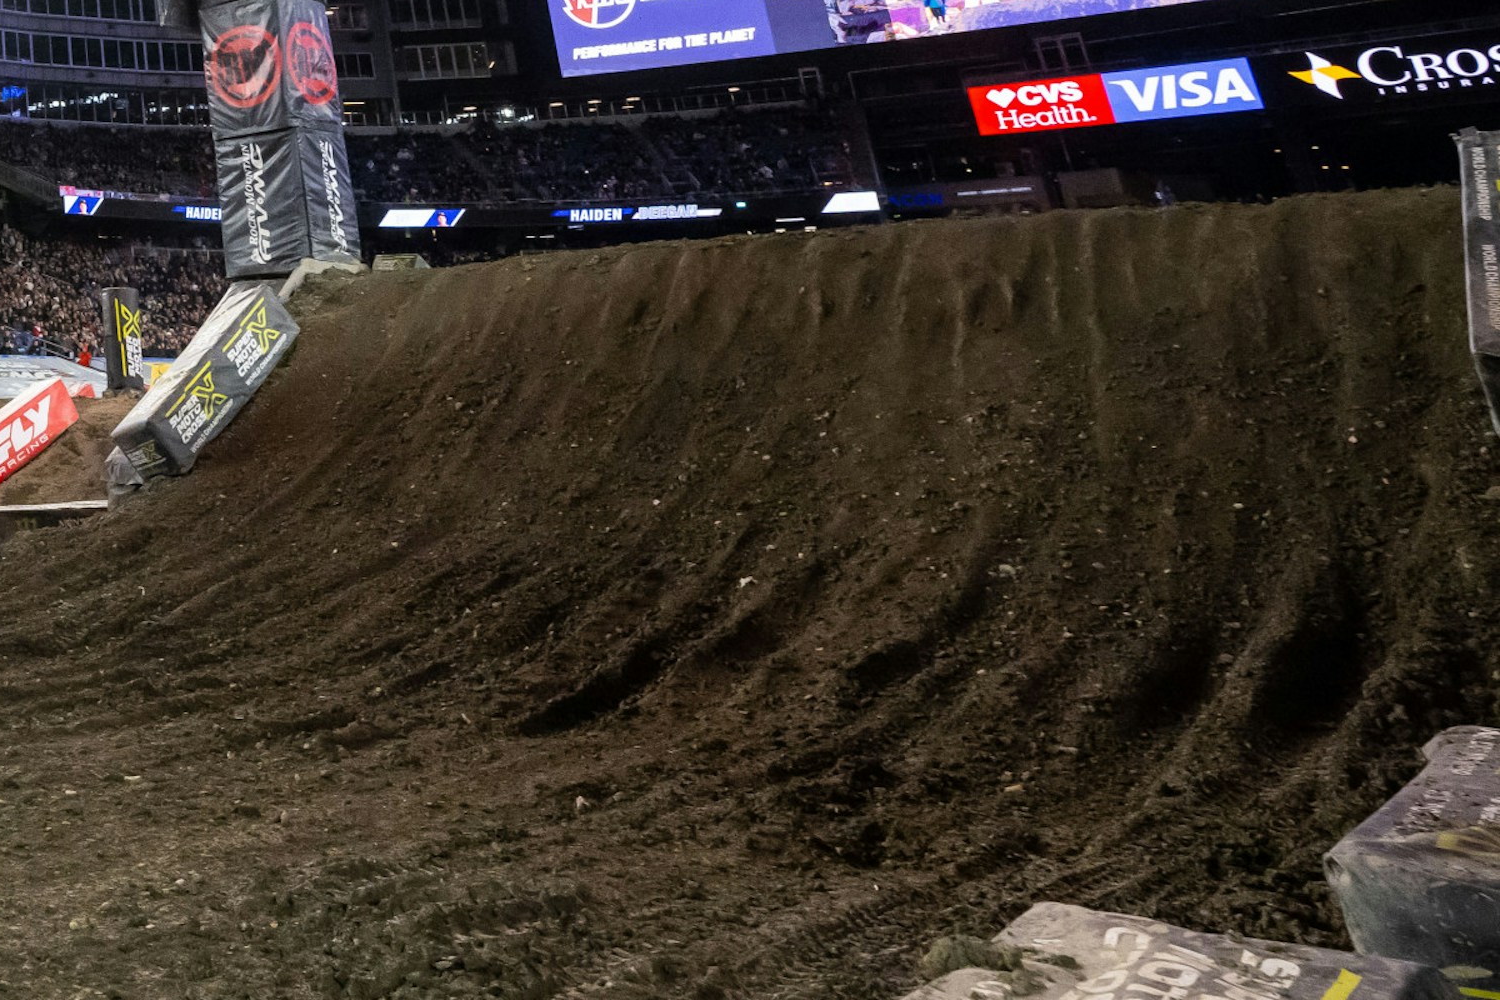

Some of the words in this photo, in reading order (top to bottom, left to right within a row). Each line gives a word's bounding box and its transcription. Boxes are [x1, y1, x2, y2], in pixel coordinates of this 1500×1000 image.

[573, 38, 657, 60] PERFORMANCE
[659, 35, 683, 51] FOR
[684, 32, 708, 48] THE
[710, 26, 756, 44] PLANET
[1016, 81, 1084, 106] CVS
[1108, 67, 1255, 112] VISA
[241, 144, 255, 205] MOUNTAIN
[185, 206, 222, 220] HAIDE
[247, 207, 258, 245] ROCKY
[569, 208, 623, 222] HAIDEN
[639, 204, 698, 219] DEEGAN
[1482, 244, 1498, 277] WORLD
[227, 329, 253, 362] SUPER
[235, 340, 257, 368] MOTO
[237, 344, 263, 378] CROSS
[169, 394, 199, 429] SUPER
[176, 405, 201, 434] MOTO
[181, 412, 208, 445] CROSS
